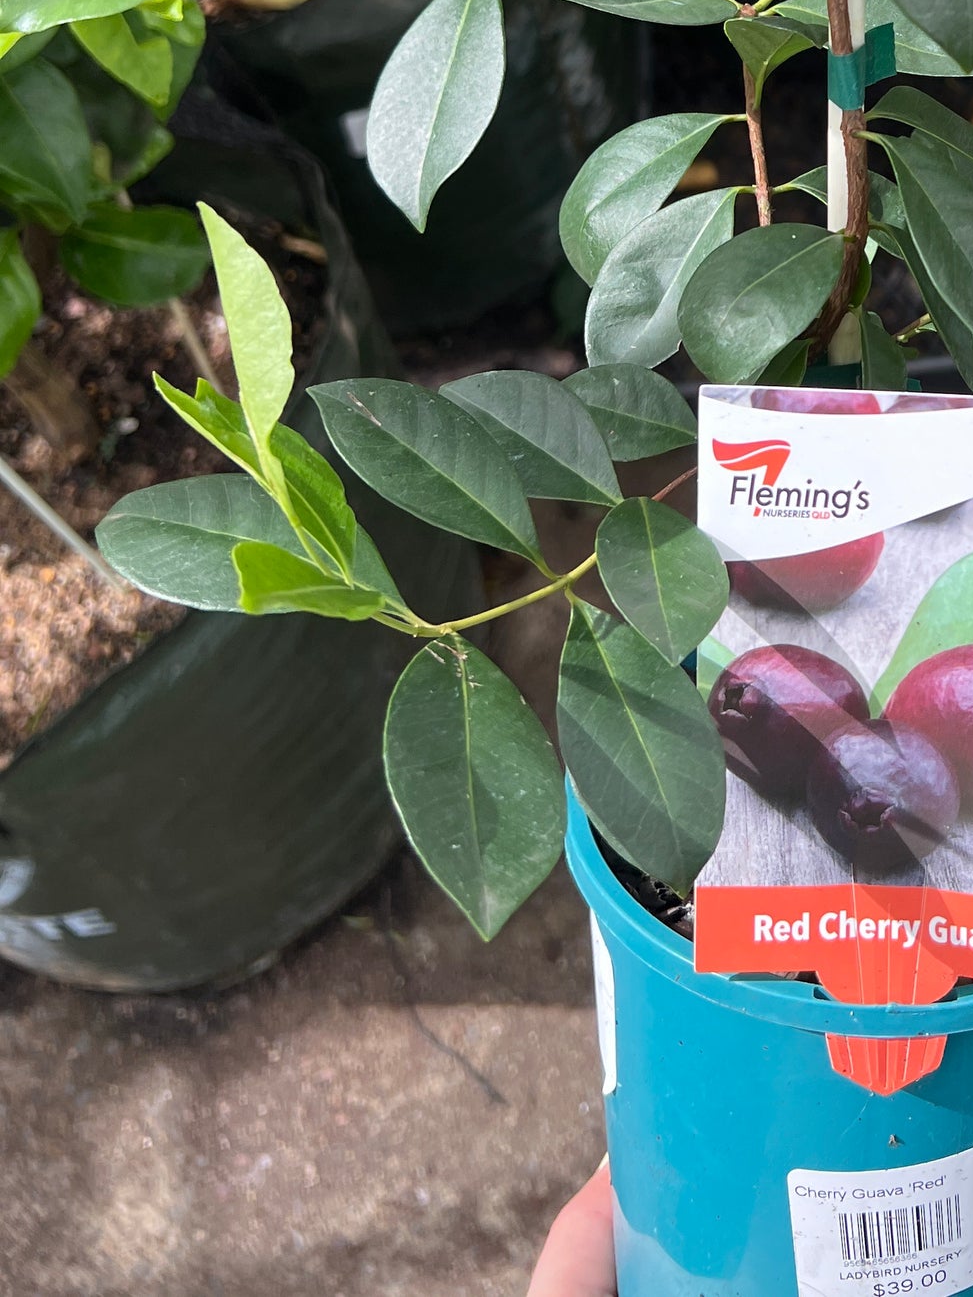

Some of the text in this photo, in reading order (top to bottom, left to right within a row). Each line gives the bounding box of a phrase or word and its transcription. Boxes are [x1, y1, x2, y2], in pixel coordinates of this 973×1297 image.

[730, 474, 870, 519] Fleming's
[762, 508, 831, 520] NURSERIES QLD
[752, 911, 811, 942] Red
[818, 910, 922, 947] Cherry
[794, 1185, 847, 1202] Cherry
[852, 1187, 904, 1200] Guava
[839, 1249, 962, 1281] LADYBIRD NURSERY
[873, 1269, 947, 1297] $39.00
